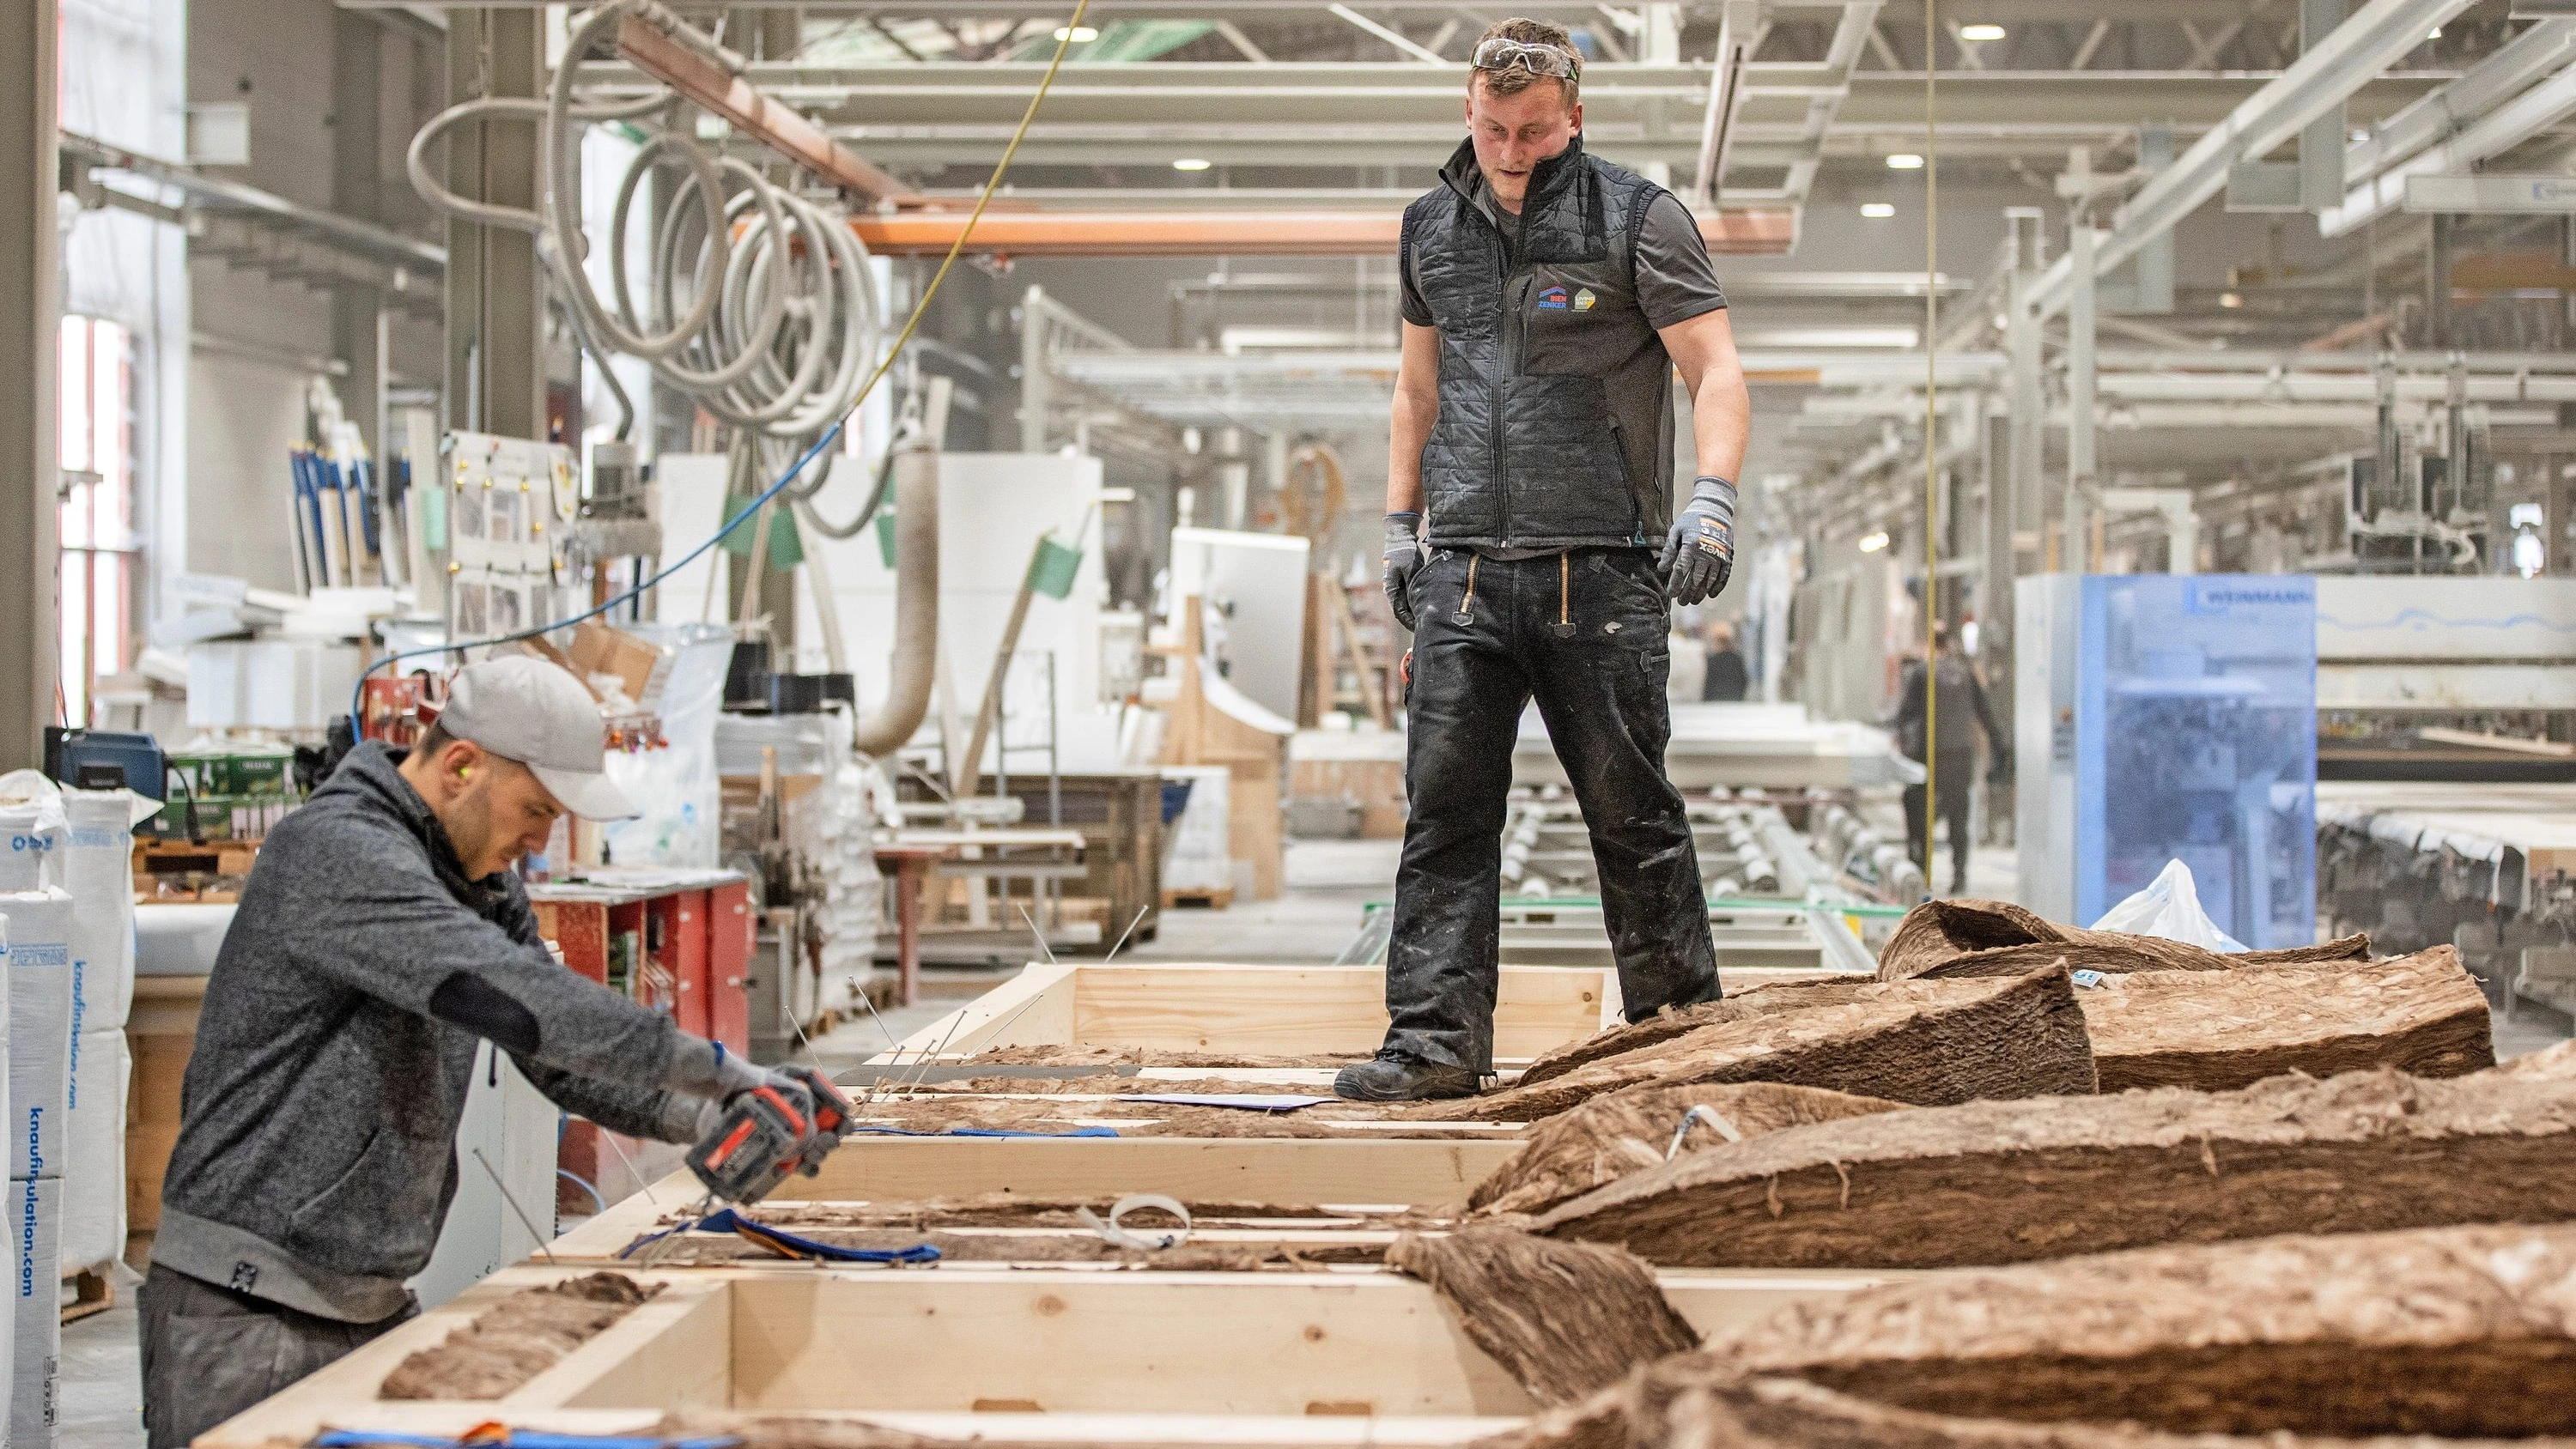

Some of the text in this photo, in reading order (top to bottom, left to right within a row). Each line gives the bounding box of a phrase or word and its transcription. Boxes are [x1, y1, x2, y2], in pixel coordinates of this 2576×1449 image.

[1538, 300, 1567, 309] ZENKER
[1698, 542, 1727, 561] uvex
[69, 959, 87, 1109] knaufinsuationcom
